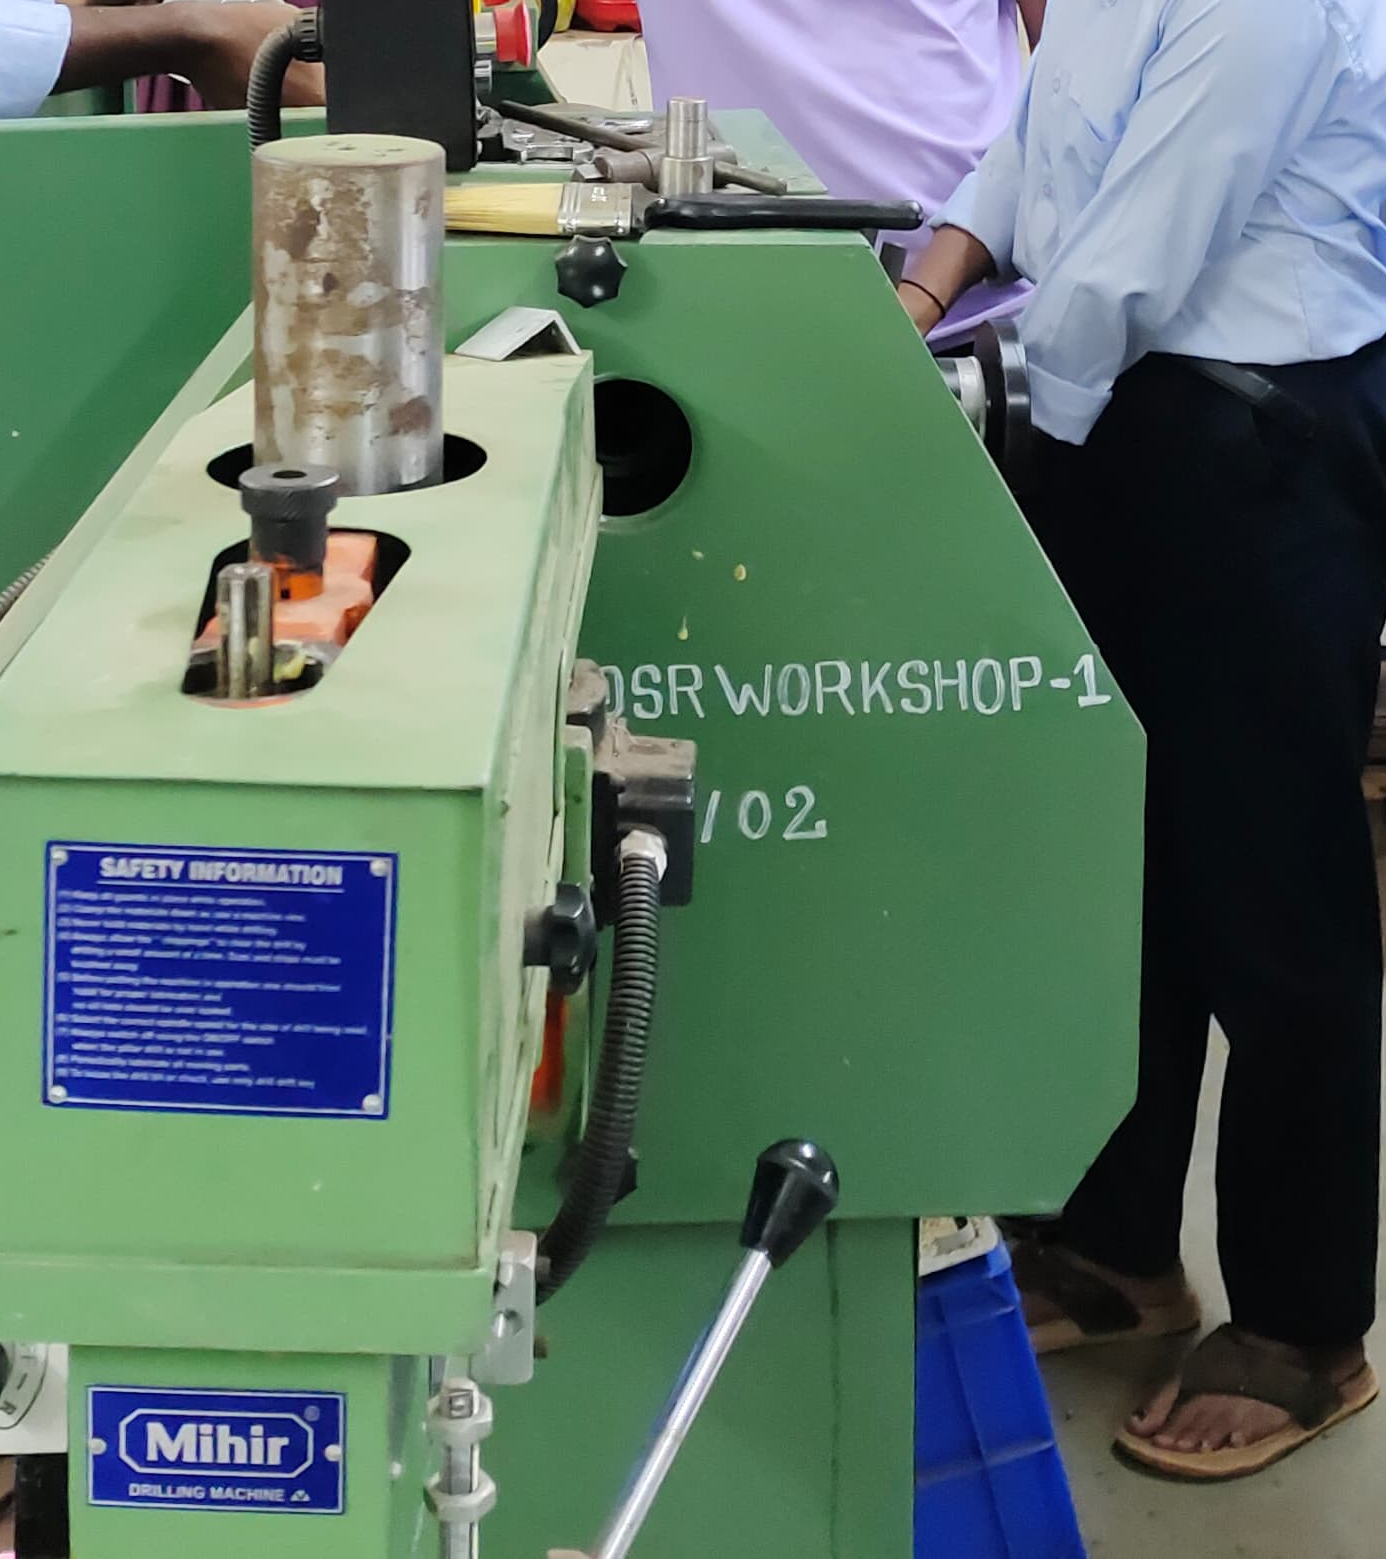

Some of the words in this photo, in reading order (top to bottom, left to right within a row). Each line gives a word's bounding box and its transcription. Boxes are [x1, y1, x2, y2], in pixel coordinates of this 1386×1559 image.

[713, 653, 1112, 717] WORKSHOP-1
[99, 856, 185, 881] SAFETY
[188, 859, 344, 886] INFORMATION
[145, 1421, 290, 1466] Mihir
[128, 1482, 206, 1500] DRILLING
[209, 1486, 285, 1503] MACHINE
